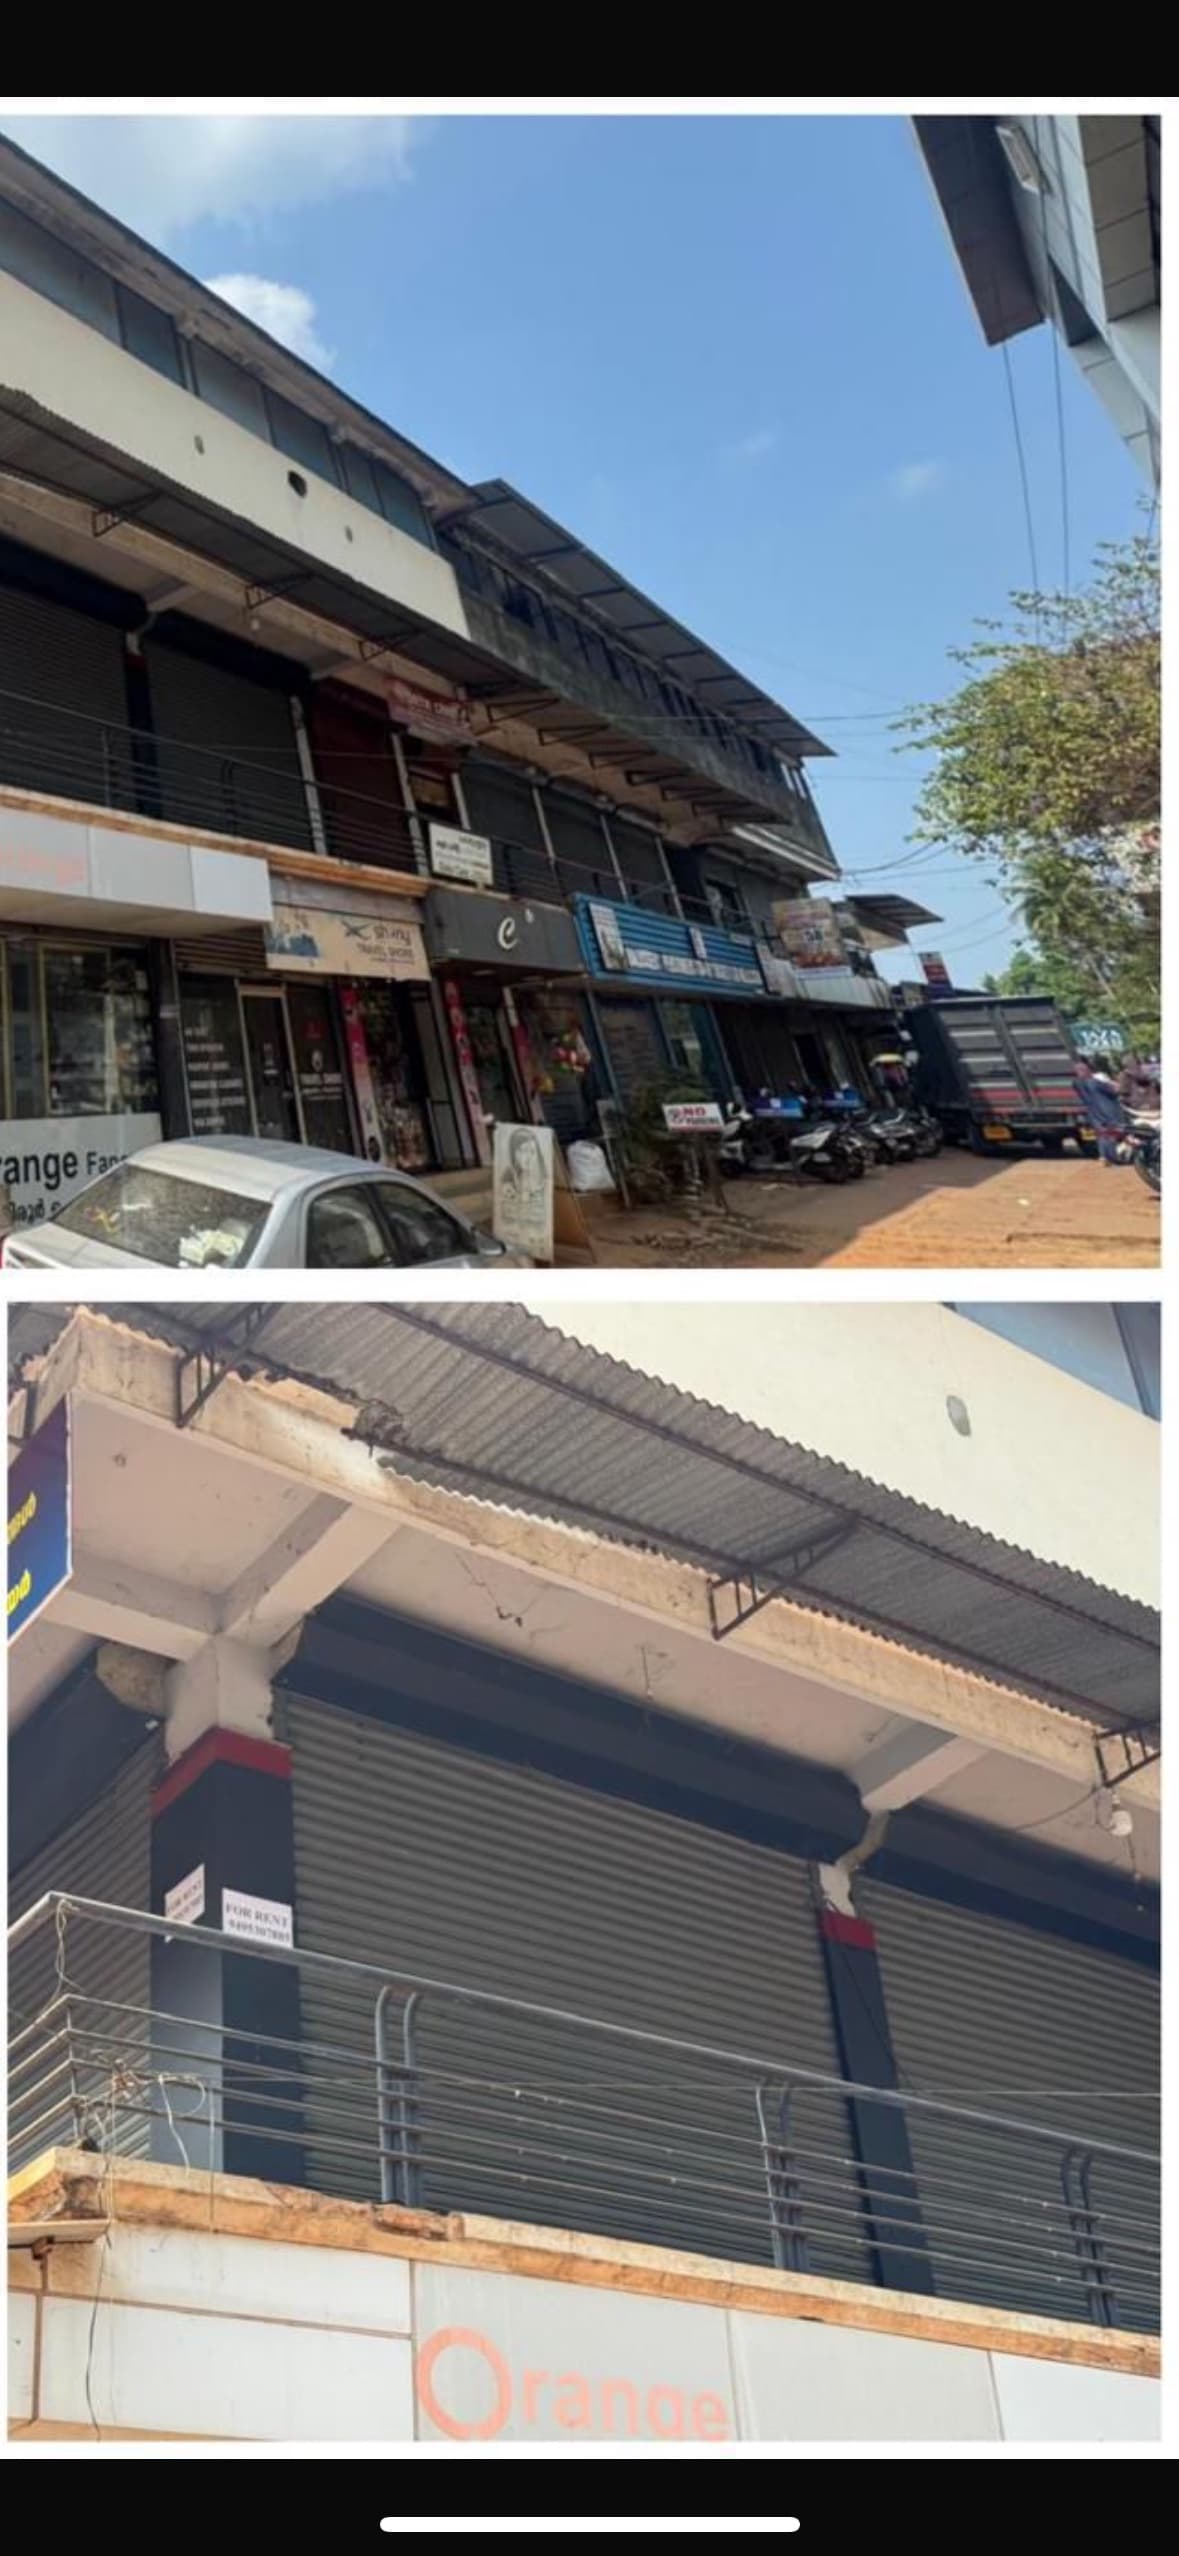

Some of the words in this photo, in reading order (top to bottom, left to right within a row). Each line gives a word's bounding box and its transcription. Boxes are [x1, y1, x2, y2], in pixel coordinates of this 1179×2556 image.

[682, 1106, 706, 1117] NO
[226, 1902, 252, 1918] FOR
[254, 1909, 288, 1928] RENT
